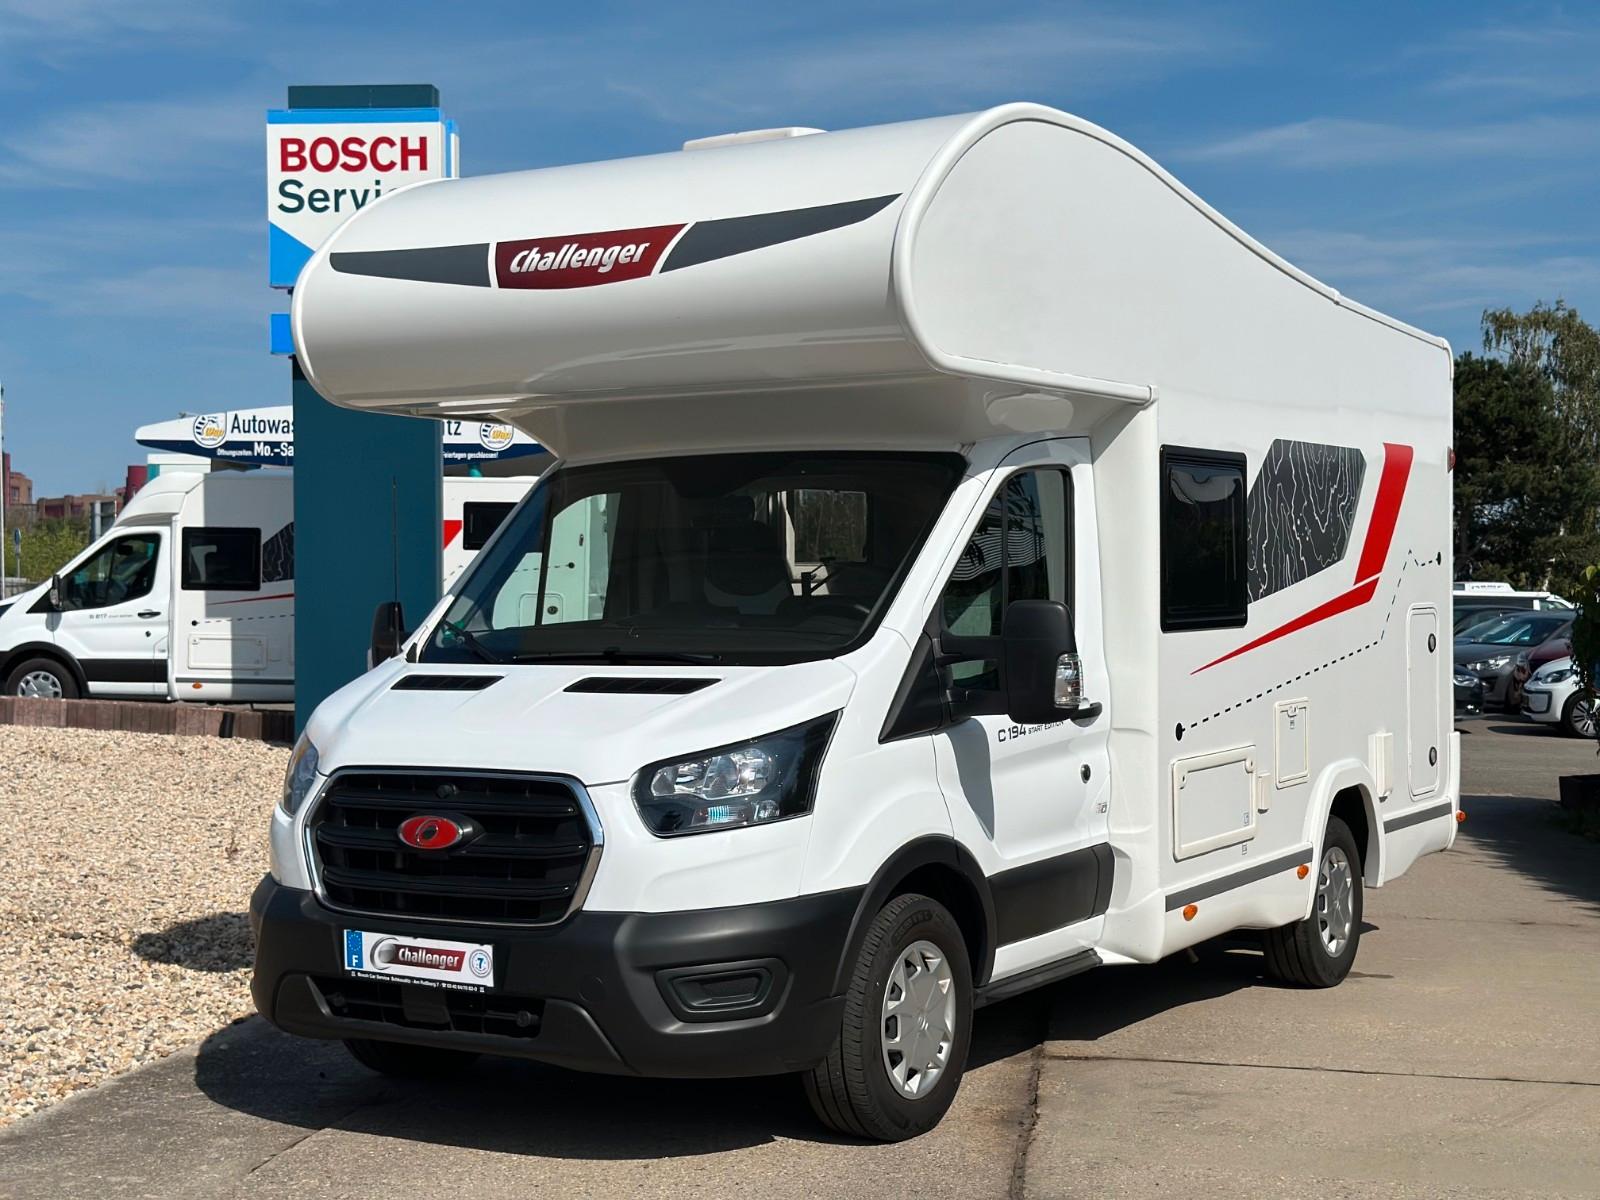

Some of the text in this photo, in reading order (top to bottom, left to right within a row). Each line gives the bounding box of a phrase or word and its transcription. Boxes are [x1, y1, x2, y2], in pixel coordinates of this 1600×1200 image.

[280, 136, 427, 172] BOSCH
[278, 179, 398, 213] Servi
[509, 243, 650, 273] Challenger
[998, 729, 1006, 742] C
[1008, 723, 1026, 740] 194
[1028, 725, 1043, 735] START
[352, 955, 359, 966] F
[398, 947, 459, 969] Challenger
